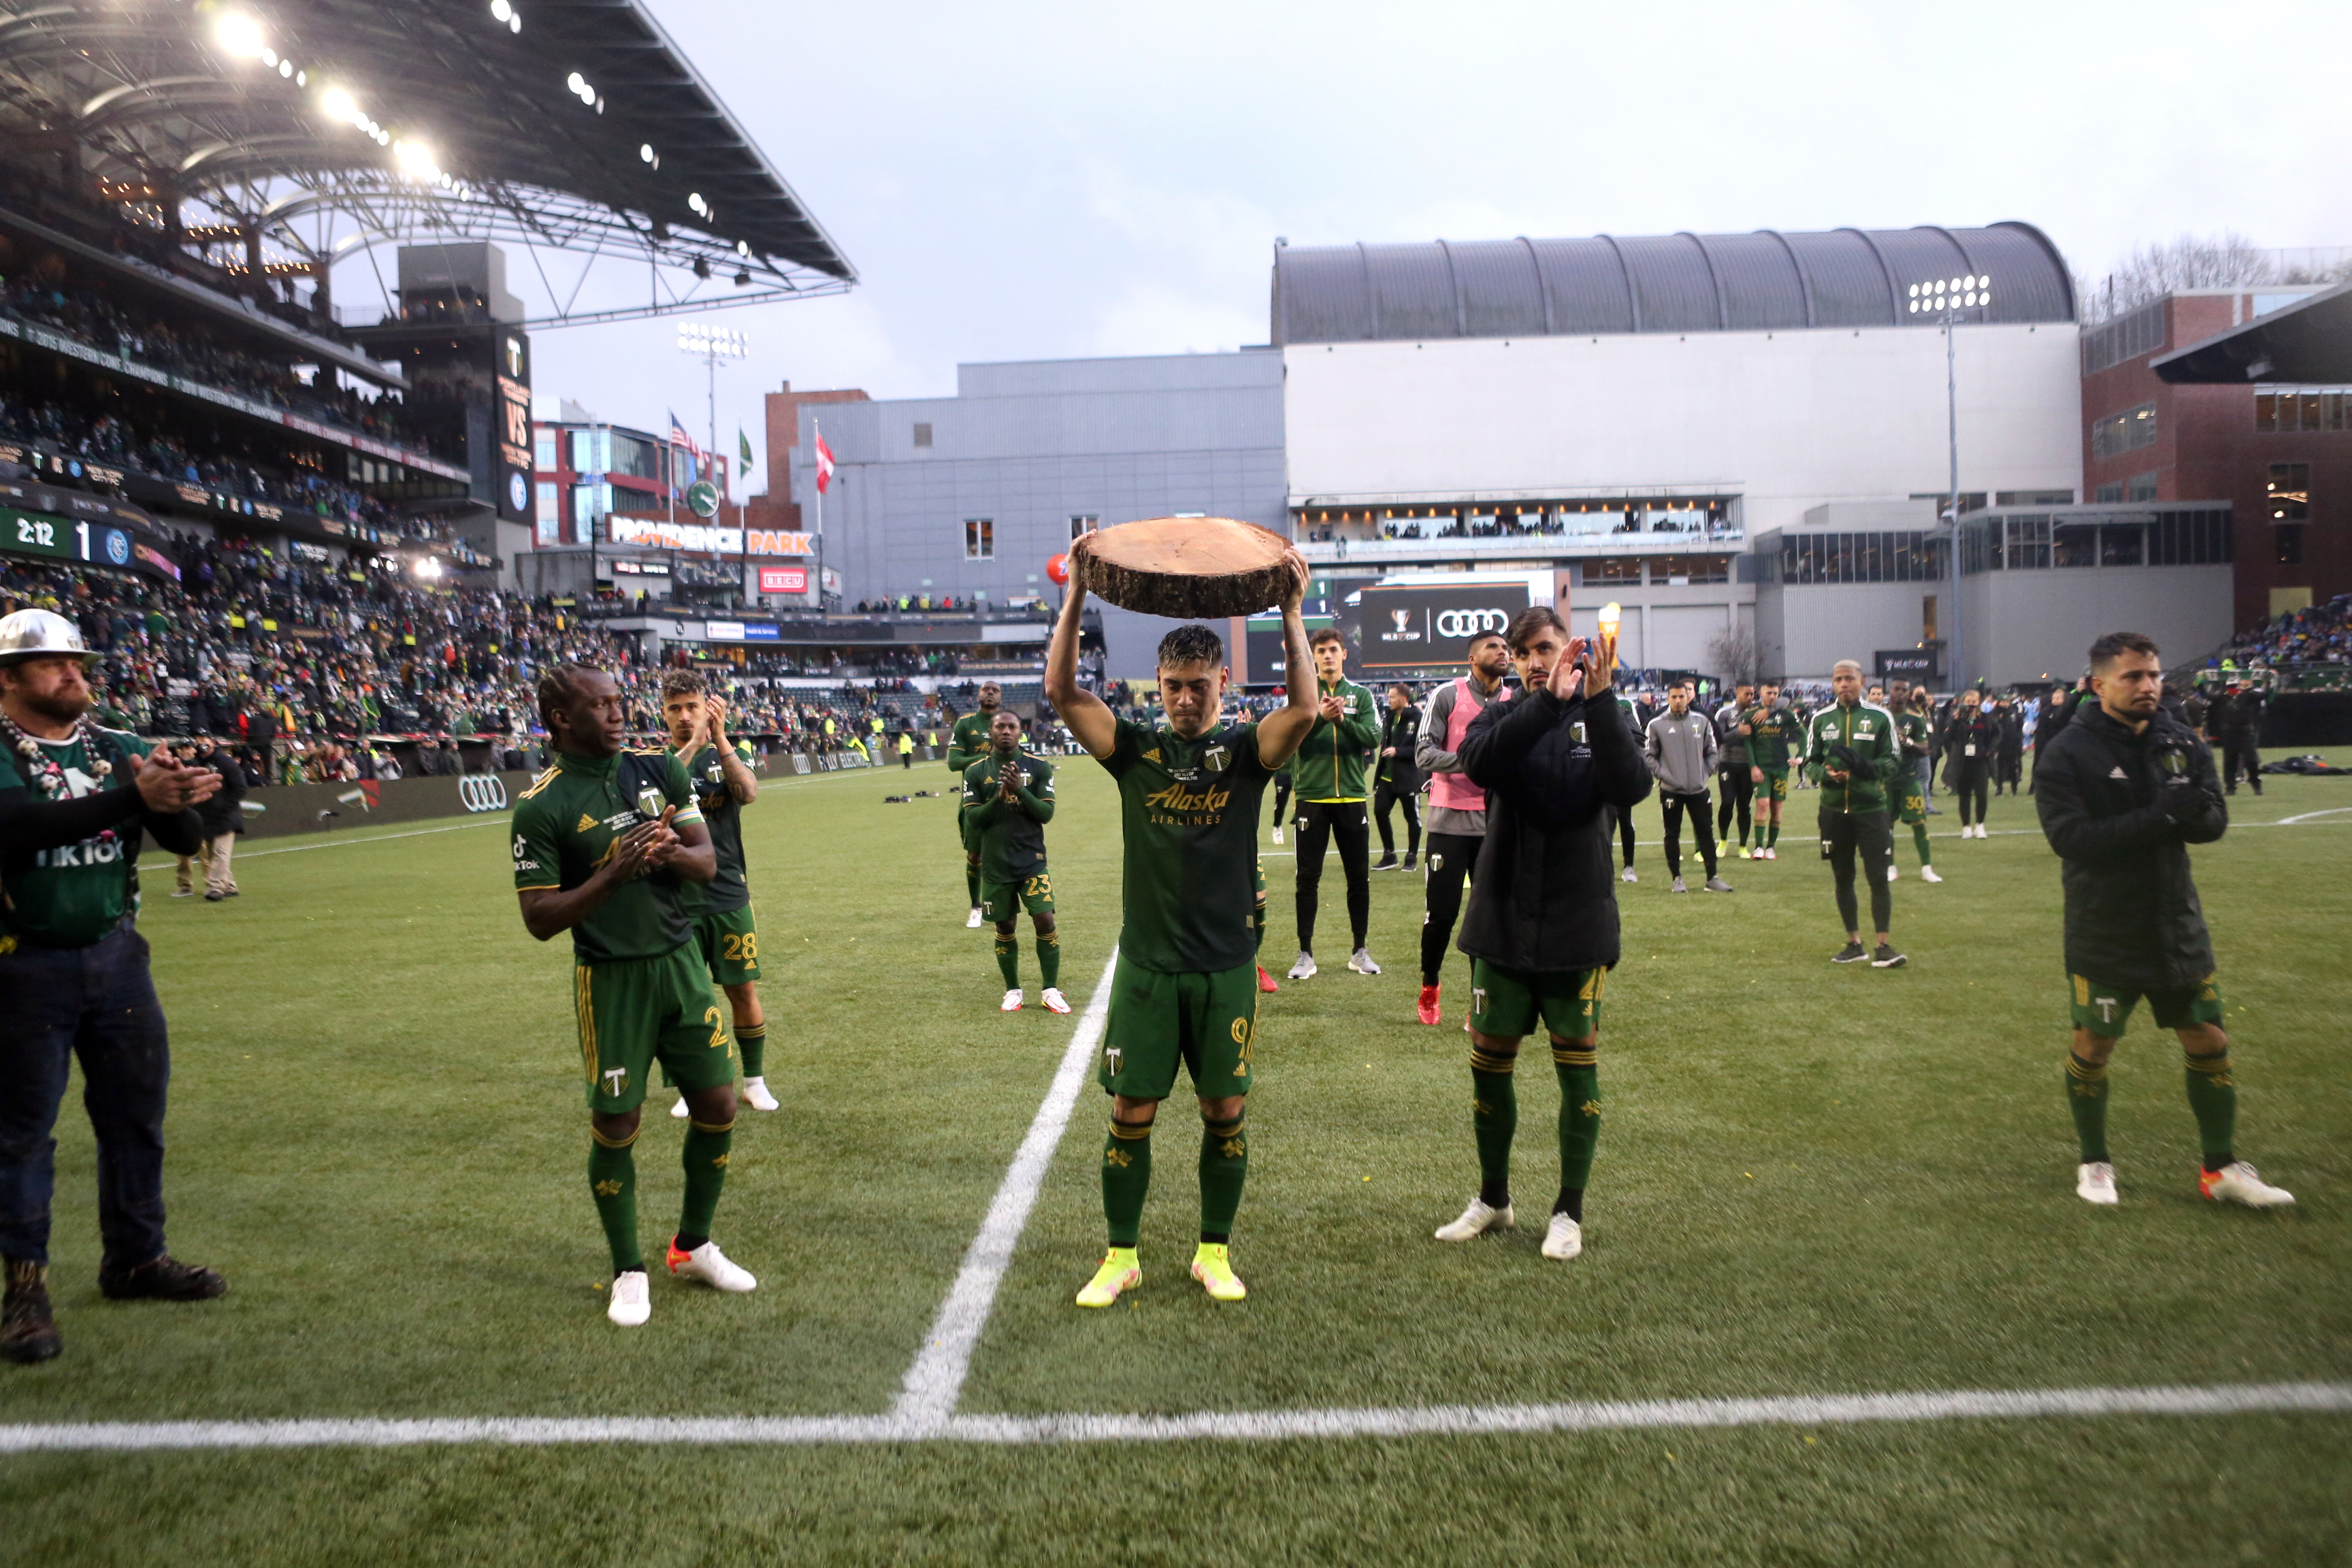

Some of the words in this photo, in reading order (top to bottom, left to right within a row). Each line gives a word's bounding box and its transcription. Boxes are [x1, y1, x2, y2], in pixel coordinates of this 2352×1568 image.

[58, 338, 99, 365] WESTERN
[122, 361, 168, 387] CHAMPIONS
[505, 401, 527, 447] VS
[90, 474, 108, 483] CITY
[102, 468, 125, 480] YORK
[17, 517, 54, 547] 2:12
[76, 521, 91, 561] 1
[611, 515, 744, 554] PROVIDENCE
[748, 529, 815, 557] PARK
[766, 576, 802, 585] BECU
[1318, 581, 1326, 595] 1
[1319, 600, 1326, 613] 1
[1382, 632, 1398, 641] MLS
[1405, 632, 1421, 641] CUP
[1142, 753, 1162, 764] adidas
[1145, 783, 1230, 813] Alaska
[1151, 815, 1222, 826] AIRLINES
[1026, 874, 1053, 896] 23
[723, 932, 758, 961] 28
[704, 1005, 728, 1049] 2
[1230, 1017, 1248, 1059] 9
